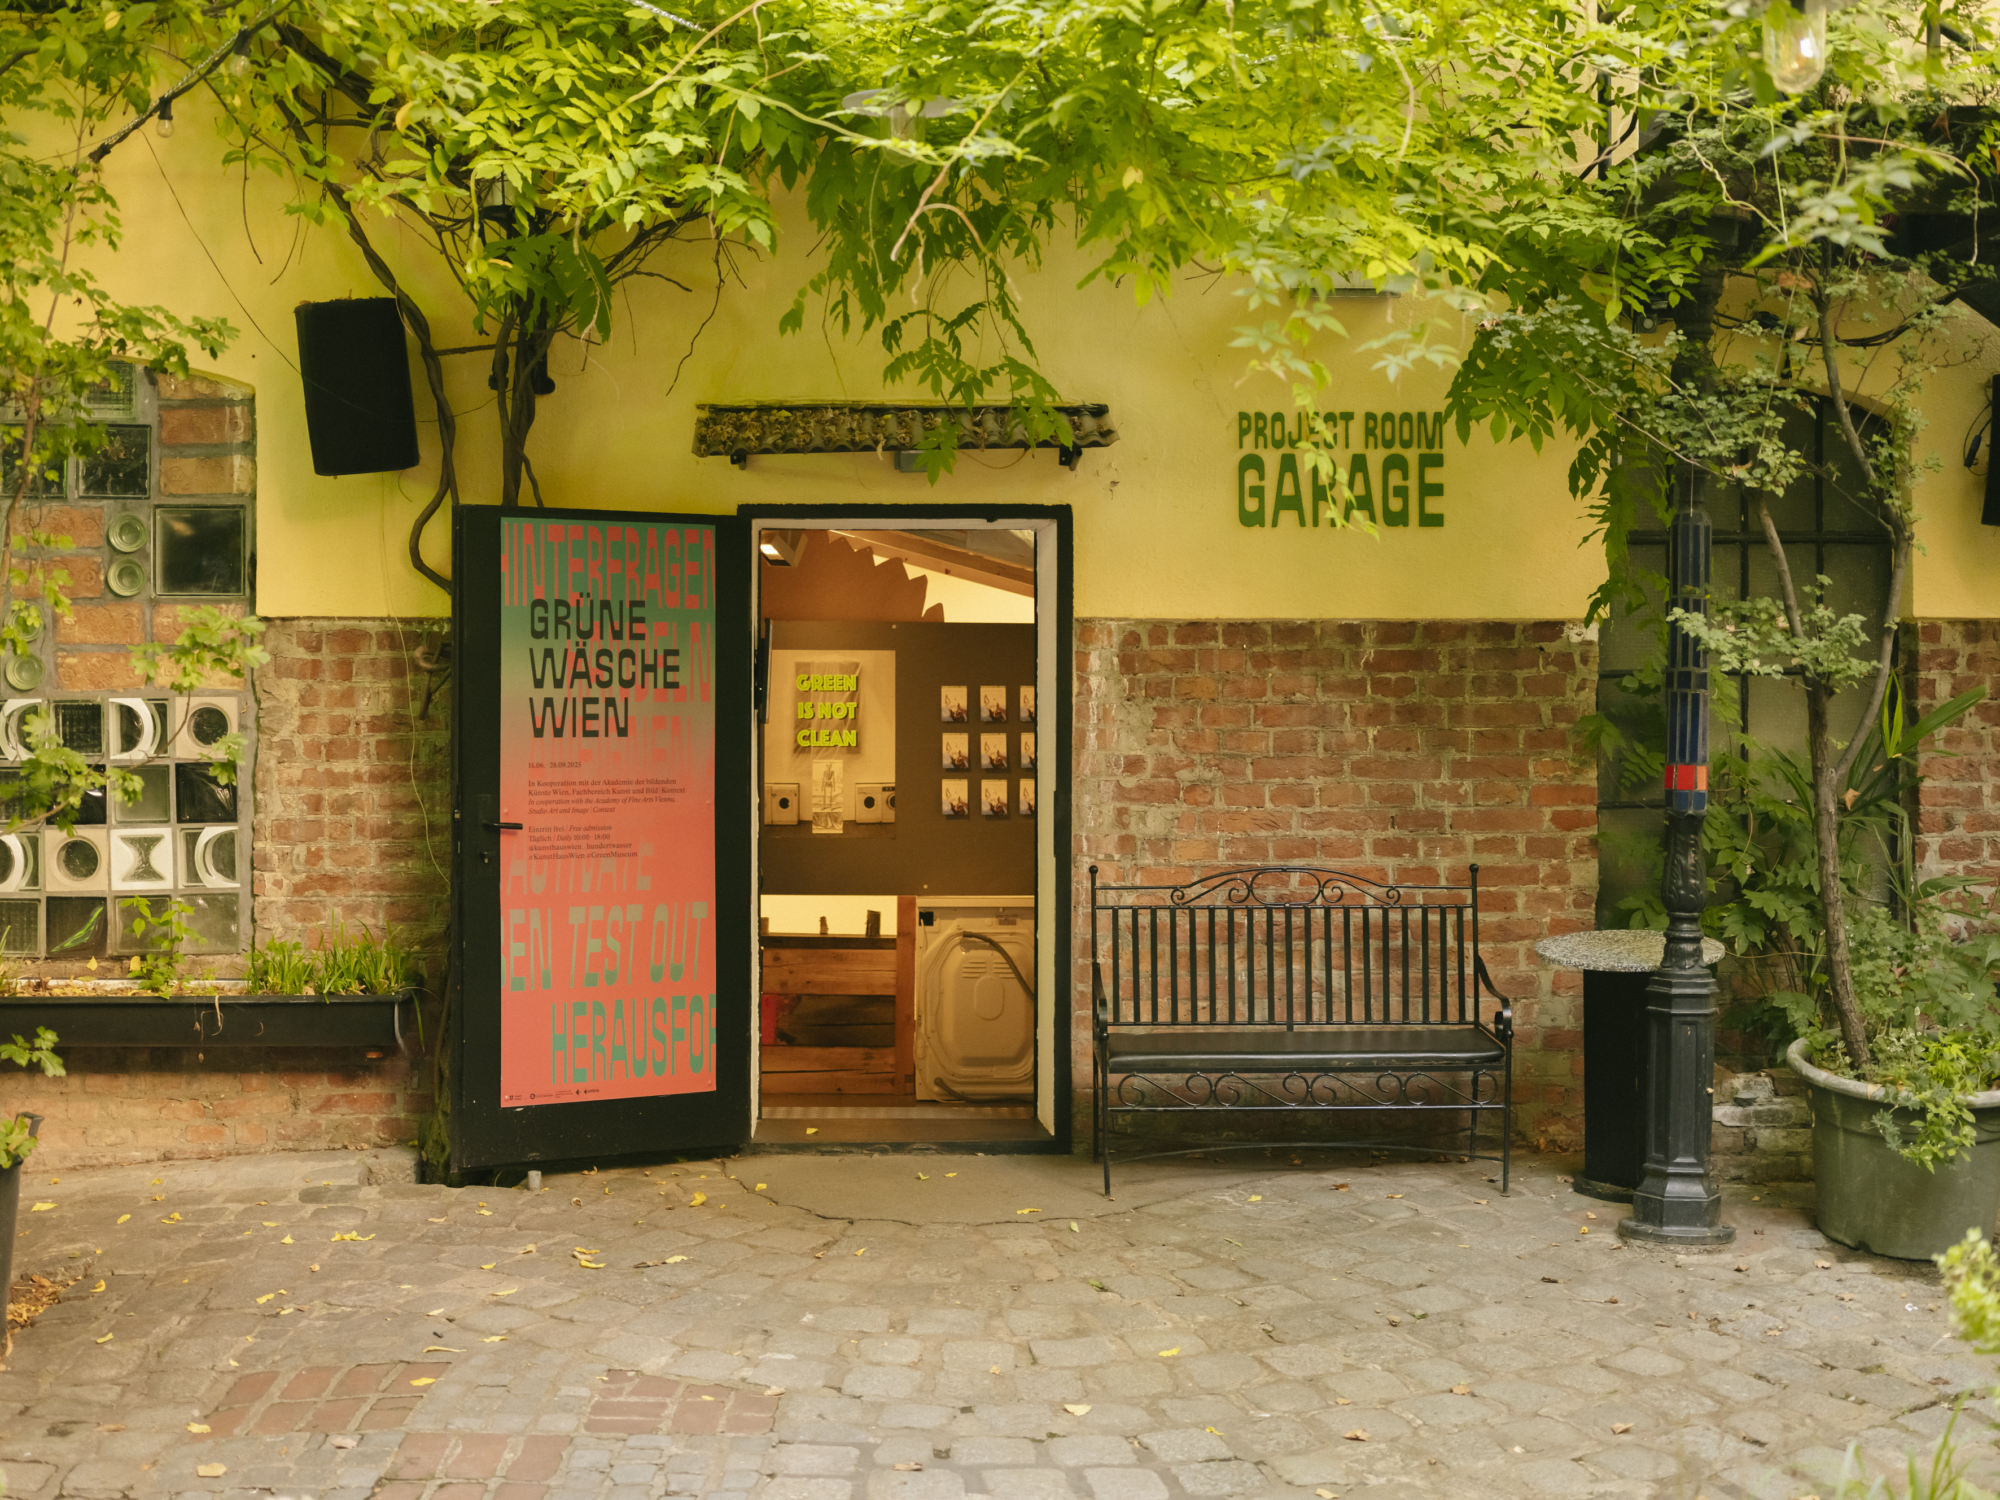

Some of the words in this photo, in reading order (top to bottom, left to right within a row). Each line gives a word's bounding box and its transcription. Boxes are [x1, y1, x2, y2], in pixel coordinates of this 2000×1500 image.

[1239, 412, 1354, 449] PROJECT
[1365, 412, 1443, 449] ROOM
[1238, 453, 1444, 527] GARAGE
[530, 592, 645, 640] GRÜNE
[529, 641, 680, 689] WÄSCHE
[796, 674, 858, 692] GREEN
[529, 697, 628, 738] WIEN
[798, 702, 815, 719] IS
[818, 702, 858, 719] NOT
[796, 729, 858, 747] CLEAN
[537, 780, 577, 788] Kooperation
[536, 798, 570, 806] cooperation
[556, 834, 572, 842] Daily
[568, 904, 643, 988] TEST
[649, 901, 708, 983] OUT
